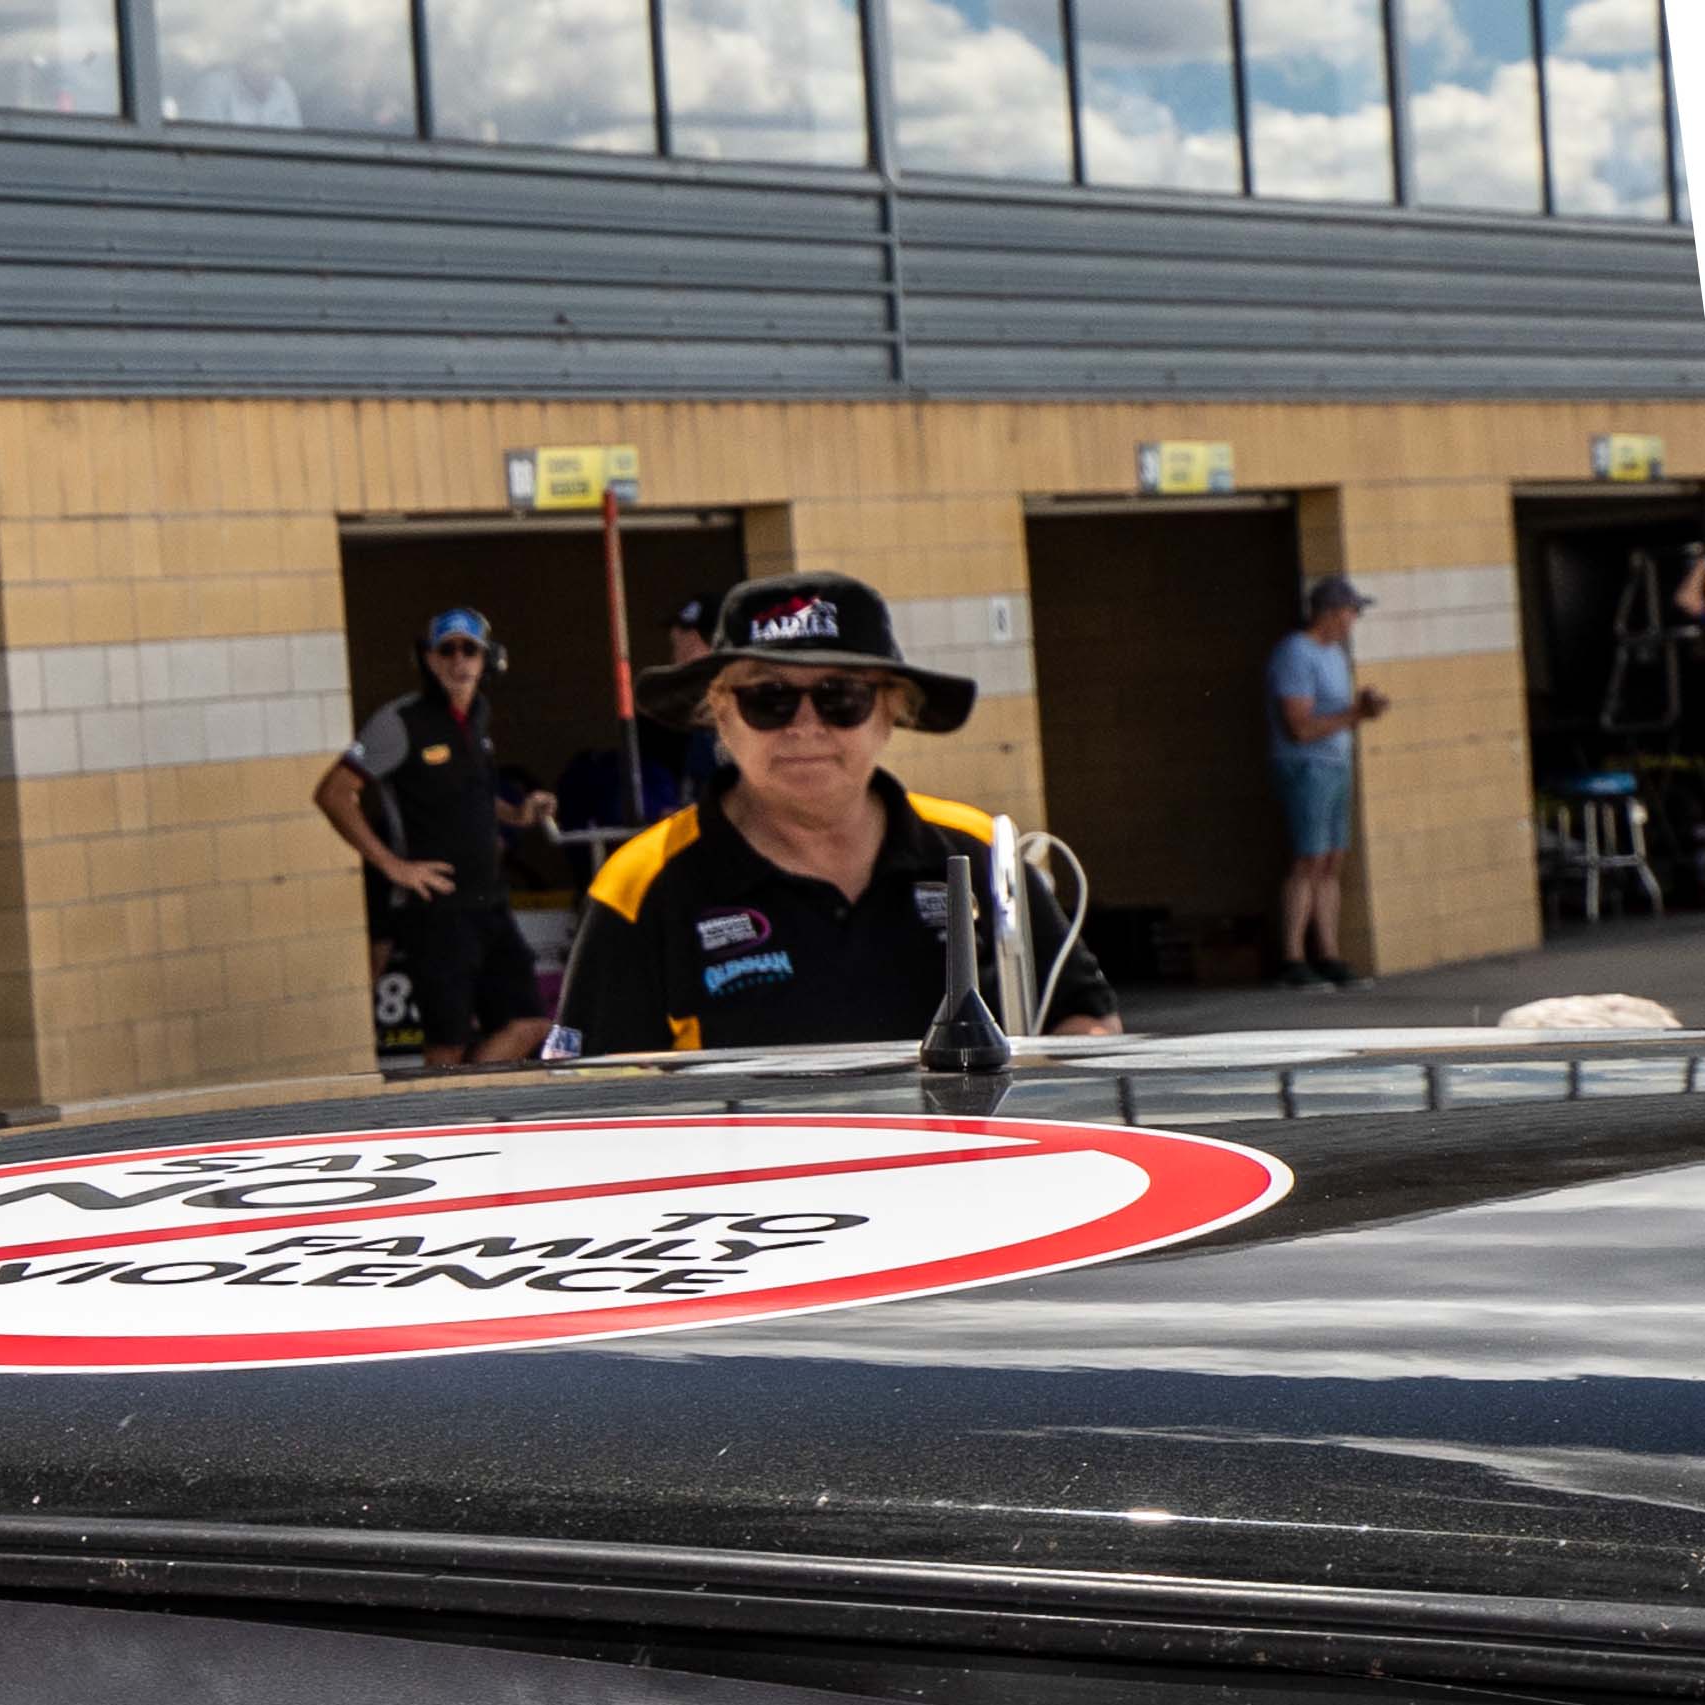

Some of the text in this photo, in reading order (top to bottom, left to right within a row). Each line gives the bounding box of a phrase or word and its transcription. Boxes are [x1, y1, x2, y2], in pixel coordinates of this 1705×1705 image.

[125, 1150, 501, 1176] SAY
[650, 1211, 870, 1234] TO
[246, 1234, 826, 1262] FAMILY
